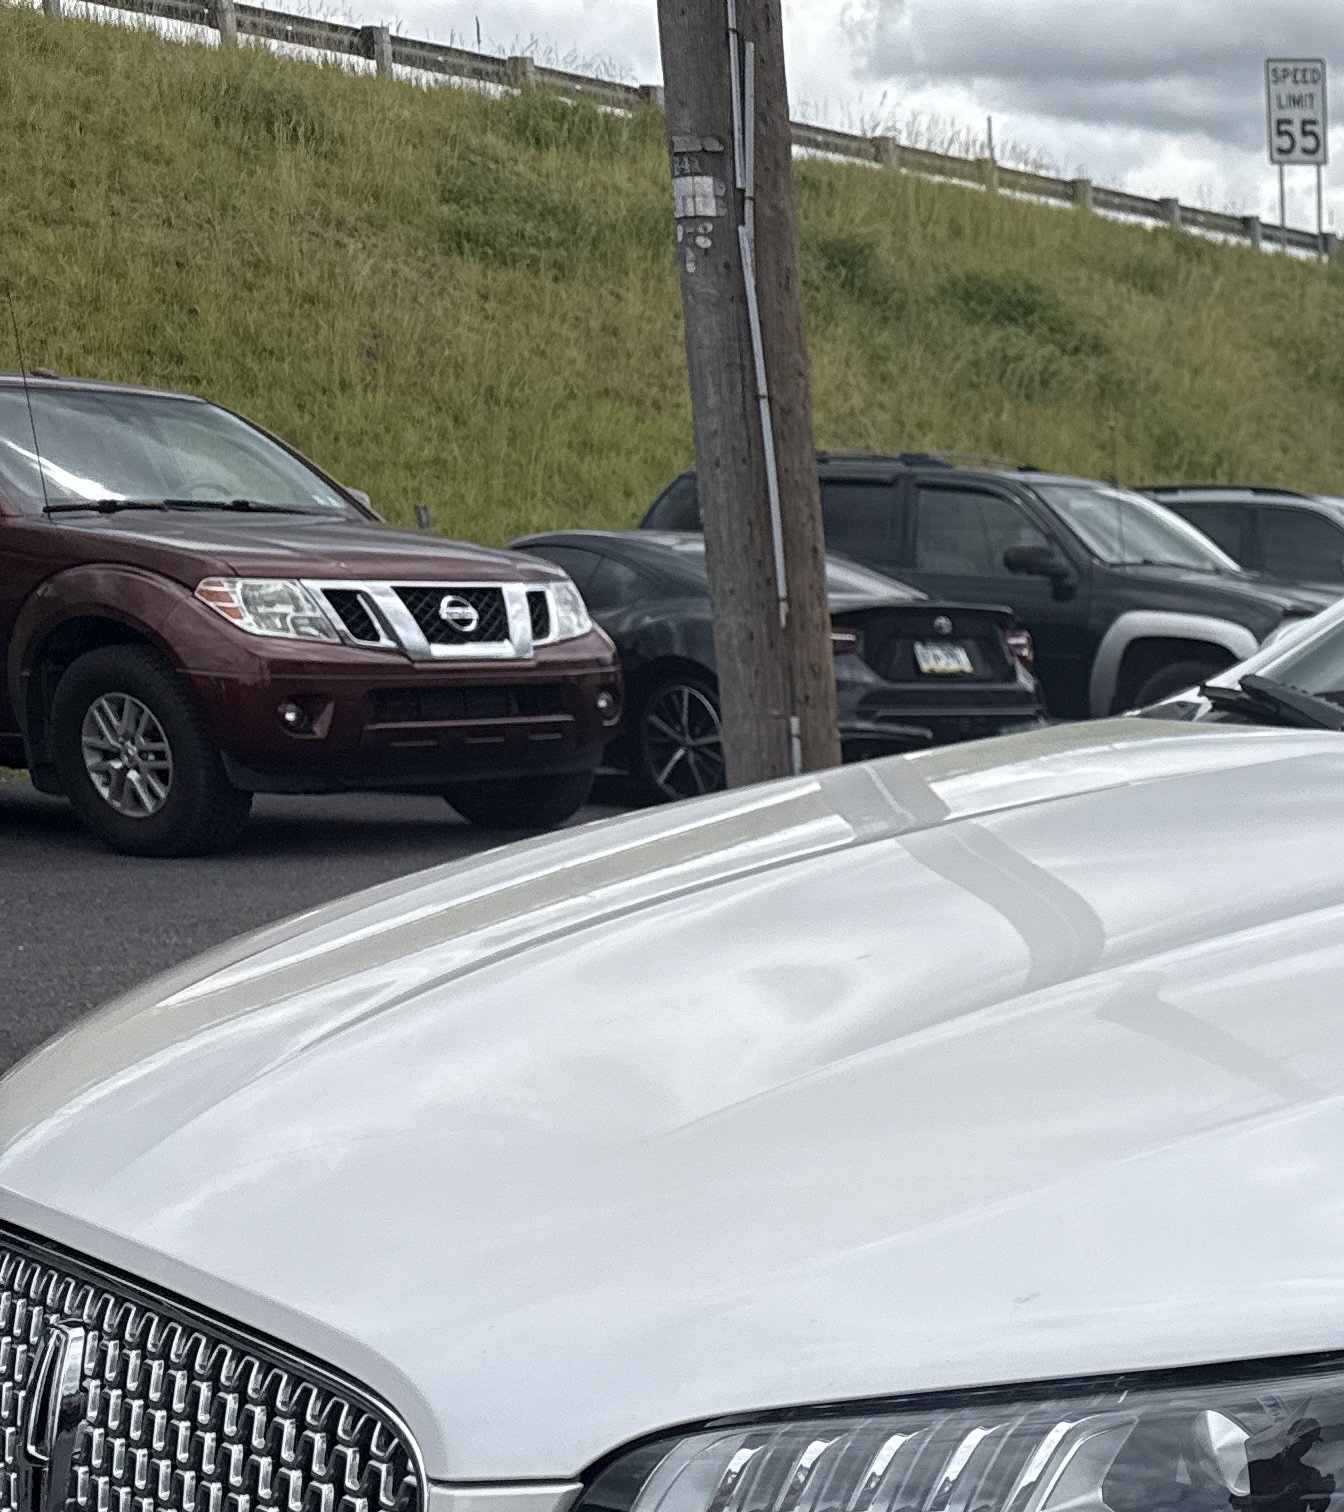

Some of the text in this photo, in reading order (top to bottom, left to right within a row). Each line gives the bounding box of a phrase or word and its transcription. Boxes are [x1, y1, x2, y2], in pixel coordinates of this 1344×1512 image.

[1272, 67, 1320, 84] SPEED
[1276, 93, 1314, 109] LIMIT
[1276, 118, 1321, 154] 55
